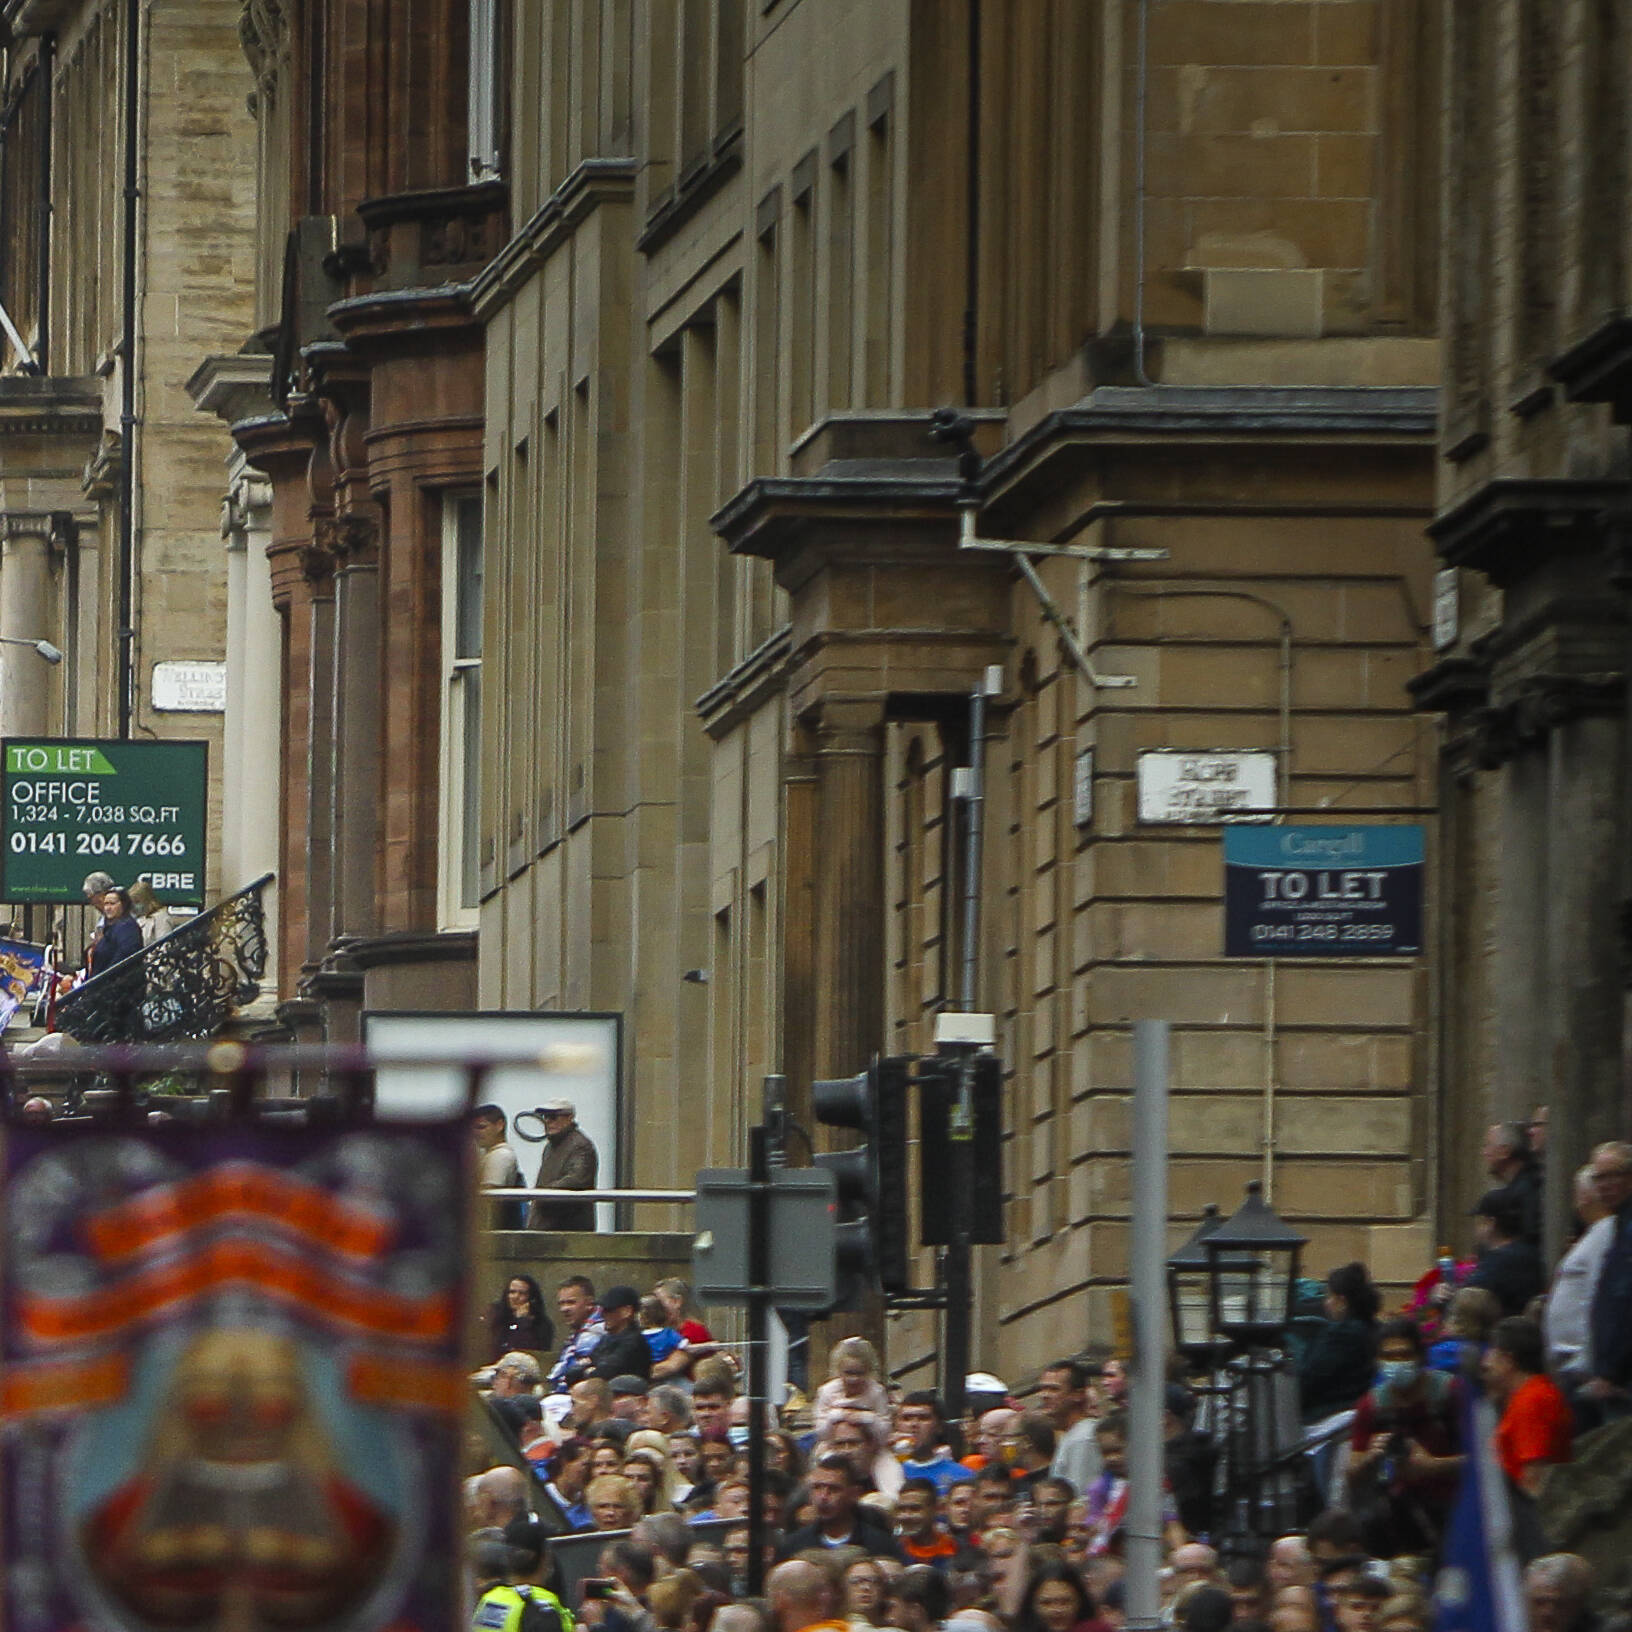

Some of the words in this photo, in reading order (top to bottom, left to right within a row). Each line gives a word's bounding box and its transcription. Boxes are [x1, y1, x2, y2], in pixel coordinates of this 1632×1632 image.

[12, 749, 48, 770] TO
[57, 750, 95, 771] LET
[12, 781, 100, 804] OFFICE
[12, 805, 58, 823] 1,324
[75, 806, 124, 824] 7,038
[129, 807, 180, 823] SQ.FT
[11, 832, 66, 855] 0141
[76, 833, 121, 855] 204
[127, 834, 186, 855] 7666
[1259, 872, 1308, 900] TO
[1319, 872, 1389, 900] LET
